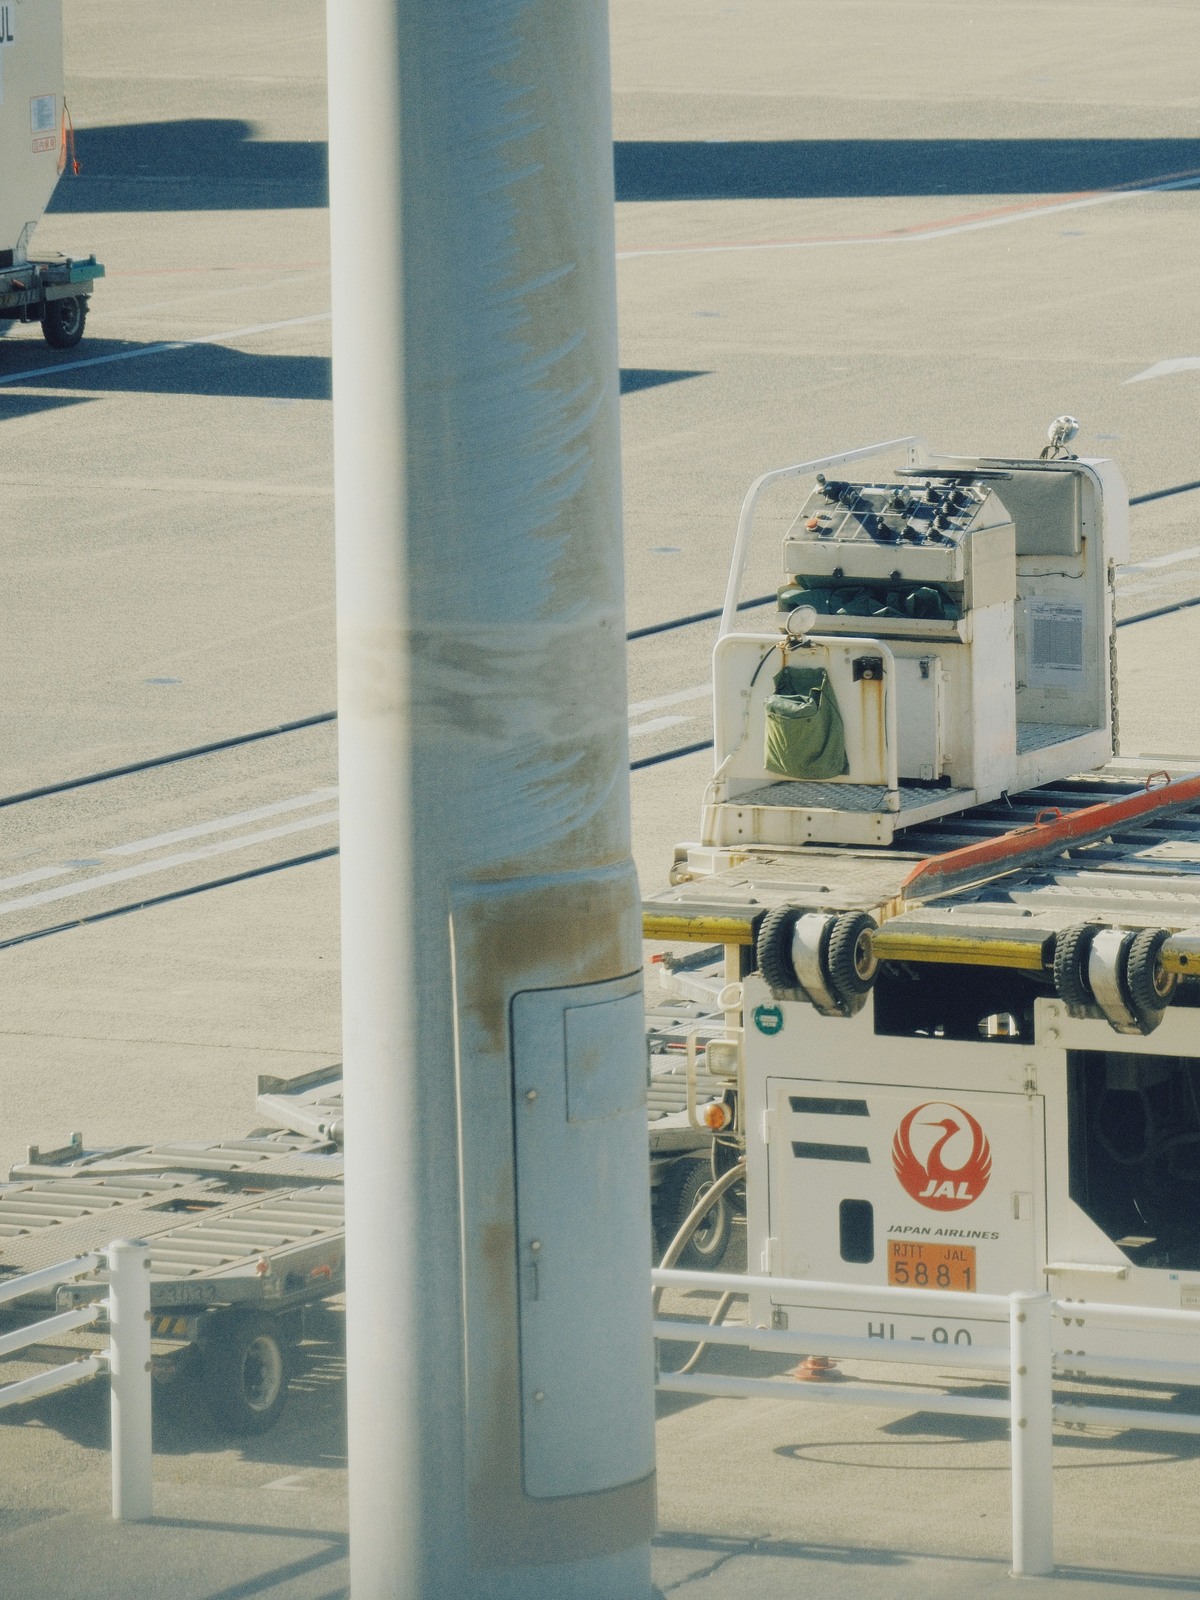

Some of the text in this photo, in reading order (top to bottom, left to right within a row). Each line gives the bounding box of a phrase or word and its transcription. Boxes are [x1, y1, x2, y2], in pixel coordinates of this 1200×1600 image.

[919, 1179, 973, 1200] JAL
[887, 1225, 1000, 1240] JAPAN AIRLINES
[893, 1243, 967, 1262] RJTT JAL
[894, 1261, 972, 1291] 5881
